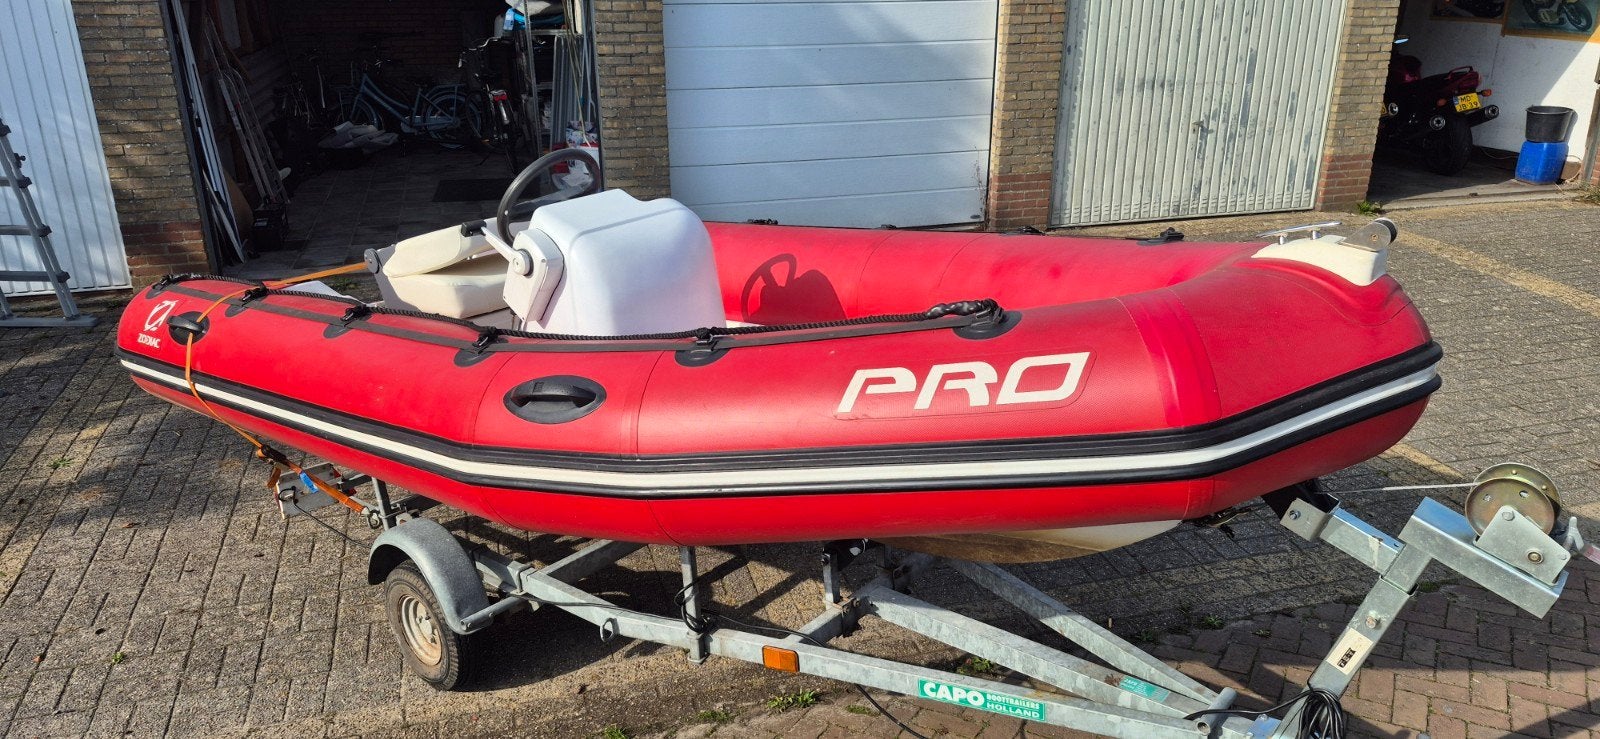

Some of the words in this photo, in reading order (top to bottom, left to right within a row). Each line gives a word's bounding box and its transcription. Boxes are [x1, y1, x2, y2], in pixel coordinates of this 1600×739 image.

[138, 332, 160, 348] ZODIAC
[836, 352, 1090, 413] PRO
[923, 682, 985, 706] CAPO
[986, 702, 1040, 718] HOLLAND
